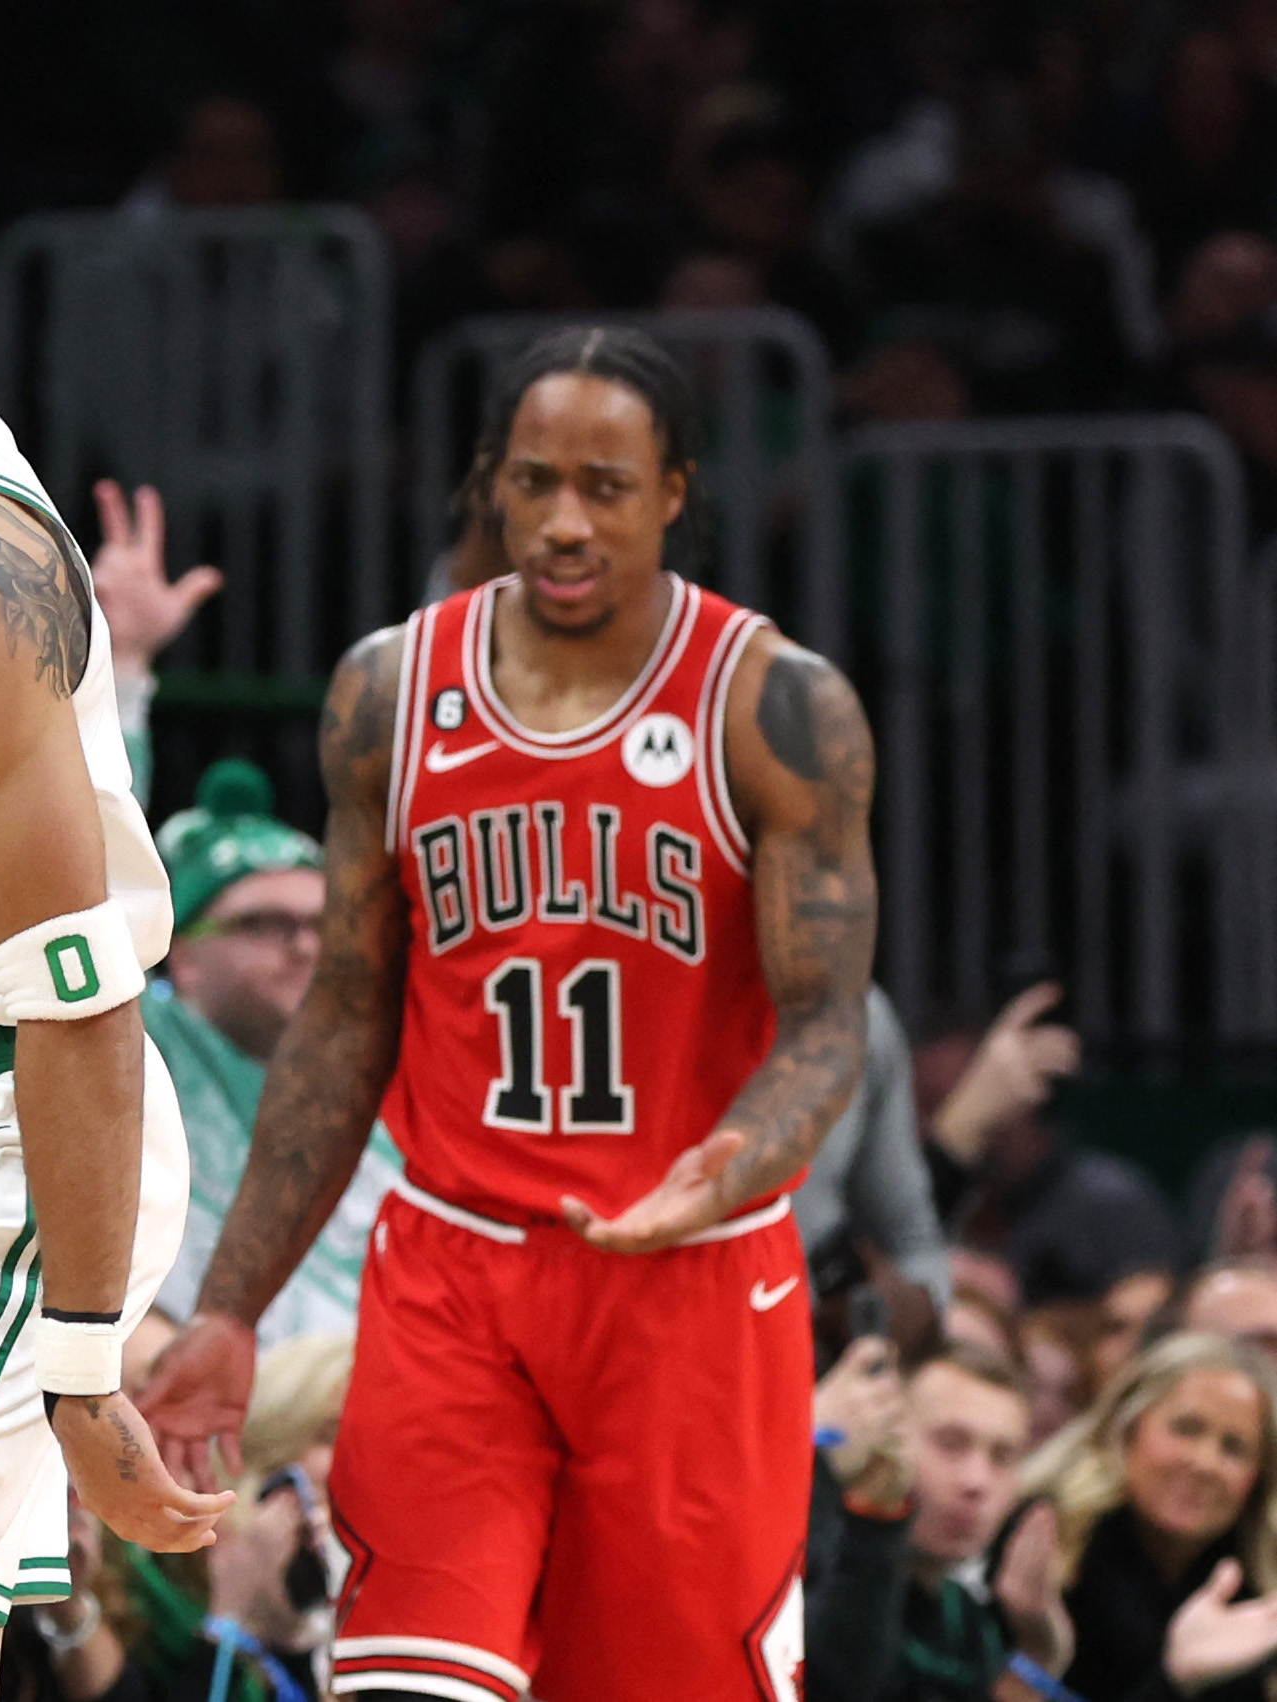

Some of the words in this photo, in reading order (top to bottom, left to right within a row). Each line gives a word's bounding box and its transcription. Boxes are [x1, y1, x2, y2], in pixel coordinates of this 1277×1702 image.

[433, 688, 465, 731] 6
[411, 801, 705, 966] BULLS
[44, 934, 100, 1003] 0
[482, 957, 634, 1134] 11
